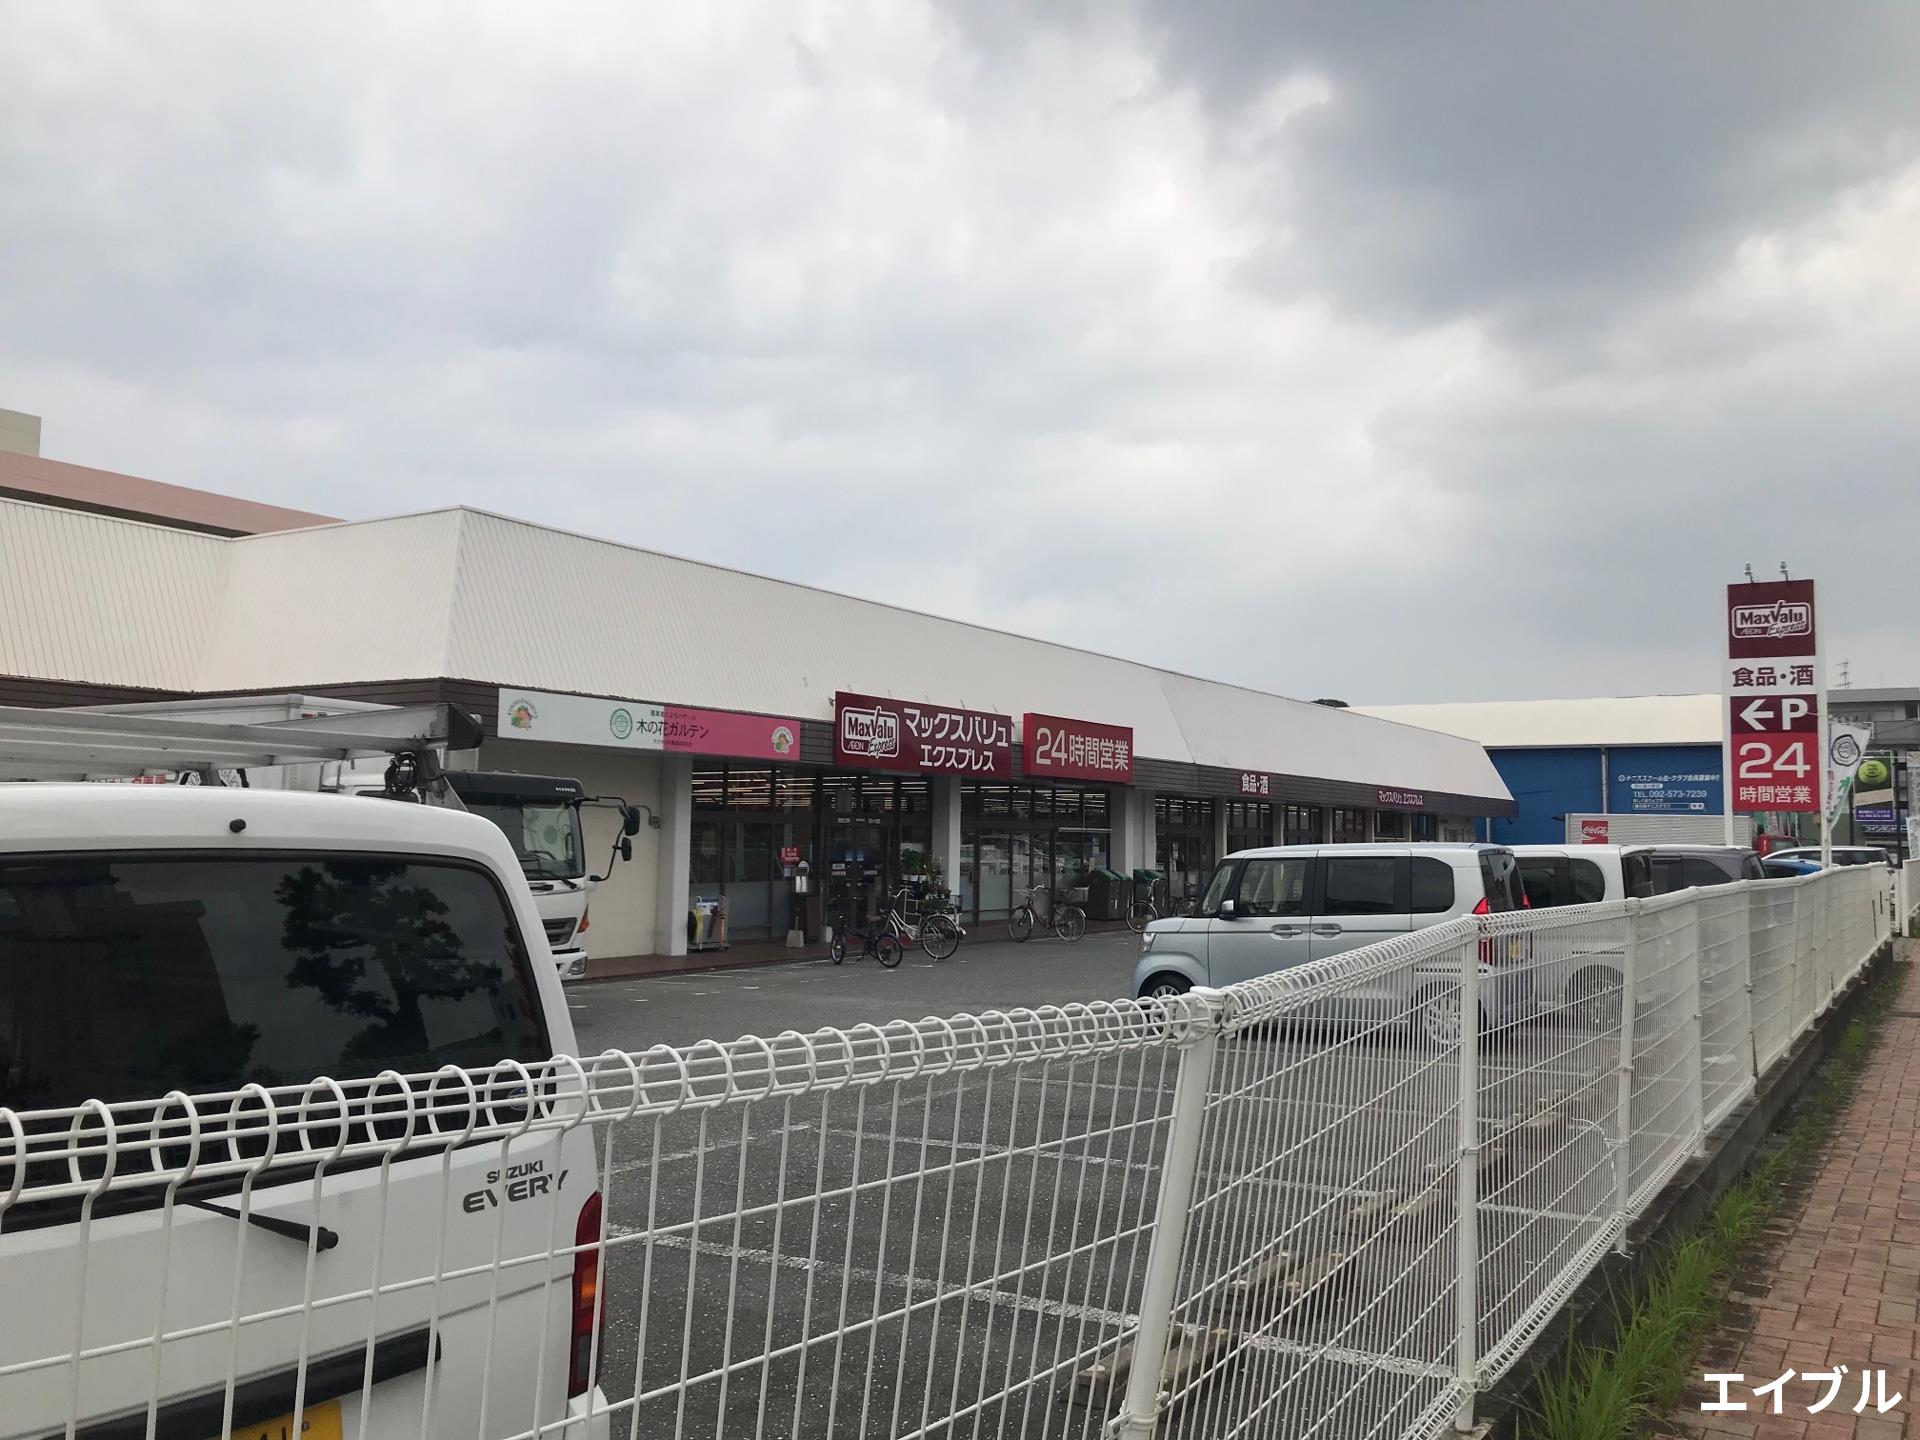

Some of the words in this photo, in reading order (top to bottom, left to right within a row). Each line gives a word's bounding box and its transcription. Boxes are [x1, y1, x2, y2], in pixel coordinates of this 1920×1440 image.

[1740, 601, 1803, 625] MaxValu
[1767, 621, 1806, 637] Express
[1732, 664, 1814, 688] 食品・酒
[848, 707, 894, 738] MaxValu
[1781, 698, 1808, 730] P
[636, 718, 709, 739] 木の花ガルテン
[903, 707, 1008, 747] マックスバリュ
[868, 736, 896, 757] Express
[919, 744, 994, 772] エクスプレス
[1035, 727, 1129, 771] 24時間営業
[1739, 742, 1811, 778] 24
[1241, 772, 1270, 795] 食品・酒
[1739, 785, 1812, 803] 時間営業
